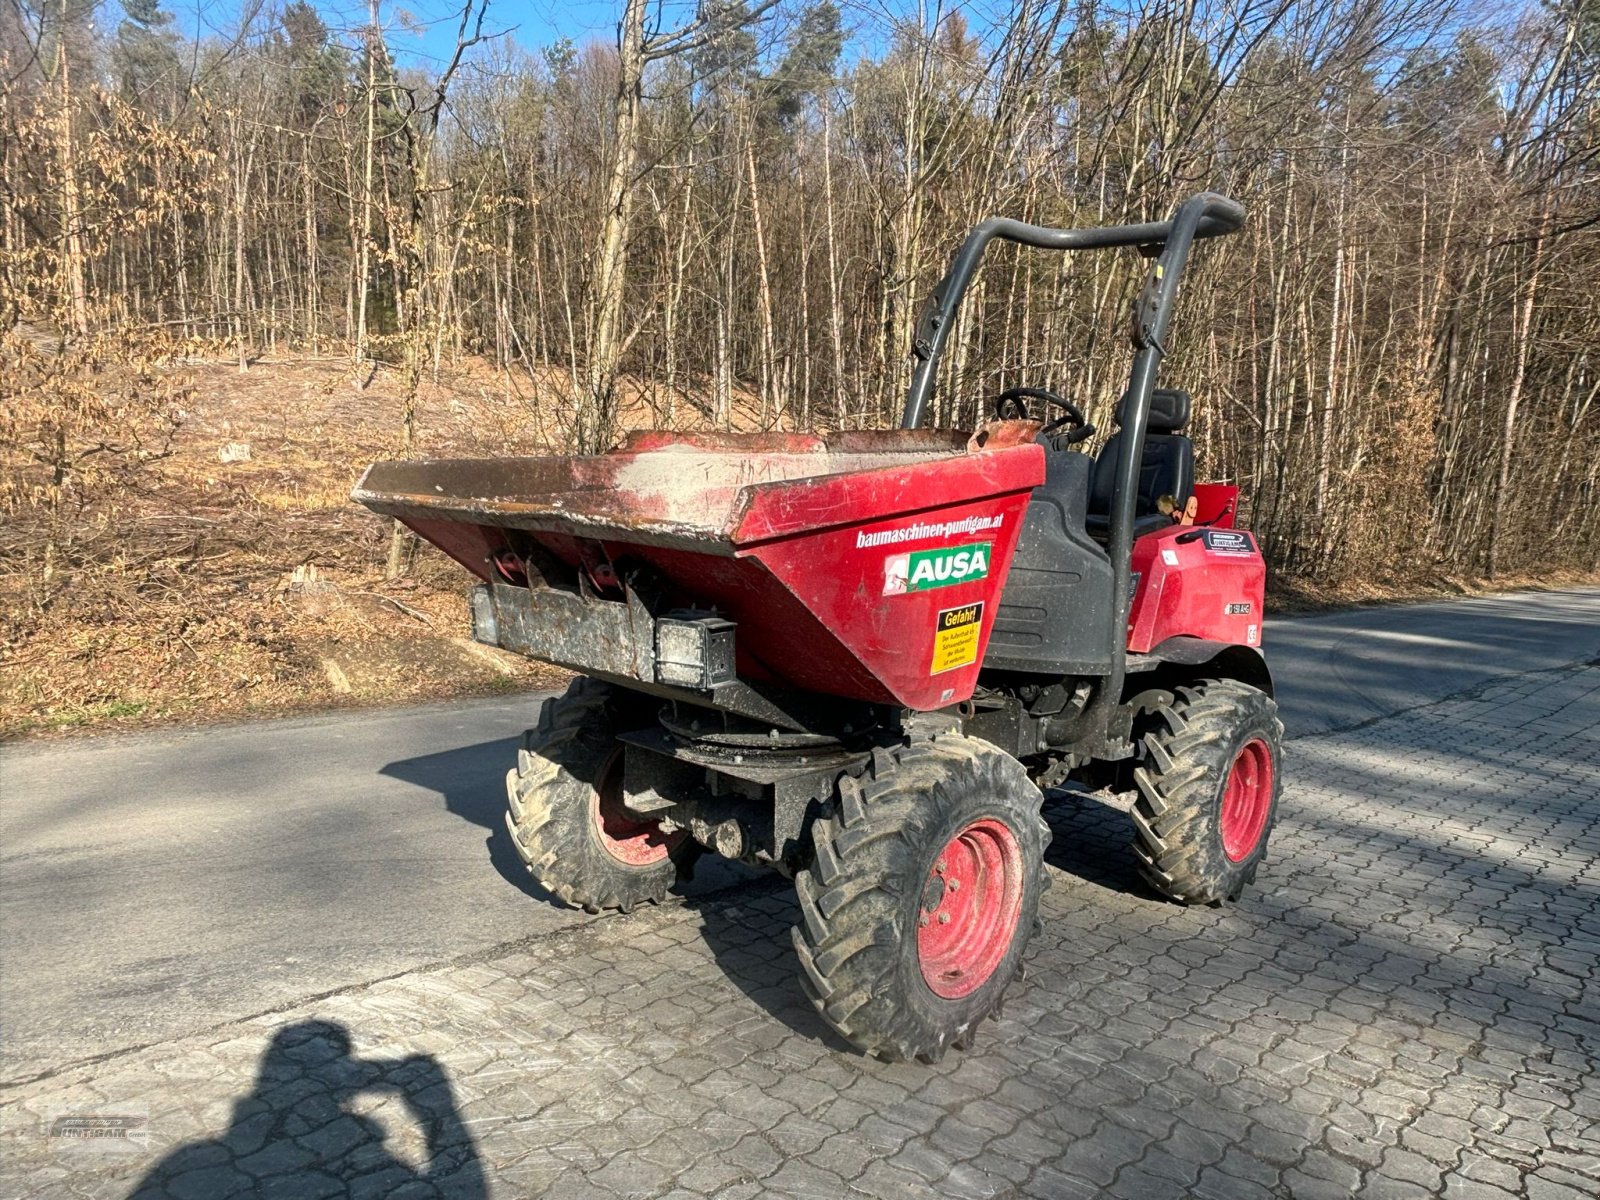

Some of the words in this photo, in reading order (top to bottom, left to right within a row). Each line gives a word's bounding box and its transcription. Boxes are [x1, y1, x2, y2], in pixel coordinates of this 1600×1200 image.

[856, 513, 1004, 549] baumaschinen-puntigam.at
[910, 550, 988, 584] AUSA
[945, 606, 977, 626] Gefahr!
